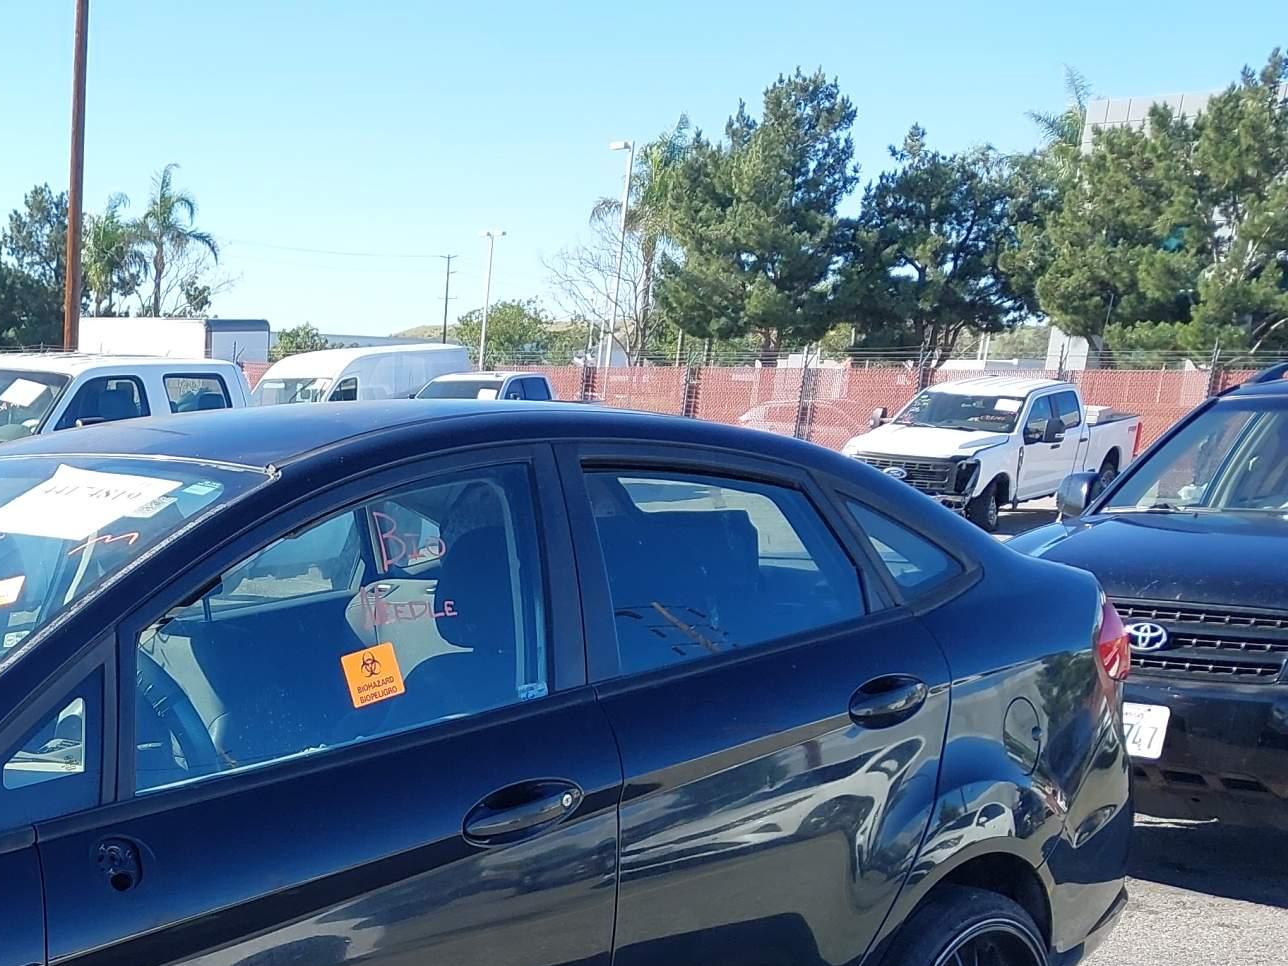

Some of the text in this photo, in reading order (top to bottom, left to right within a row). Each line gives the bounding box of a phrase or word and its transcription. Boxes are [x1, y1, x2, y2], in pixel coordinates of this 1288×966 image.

[372, 511, 447, 573] BIO
[357, 676, 395, 694] BIOHAZARD
[360, 686, 398, 704] BIOPELIGRO
